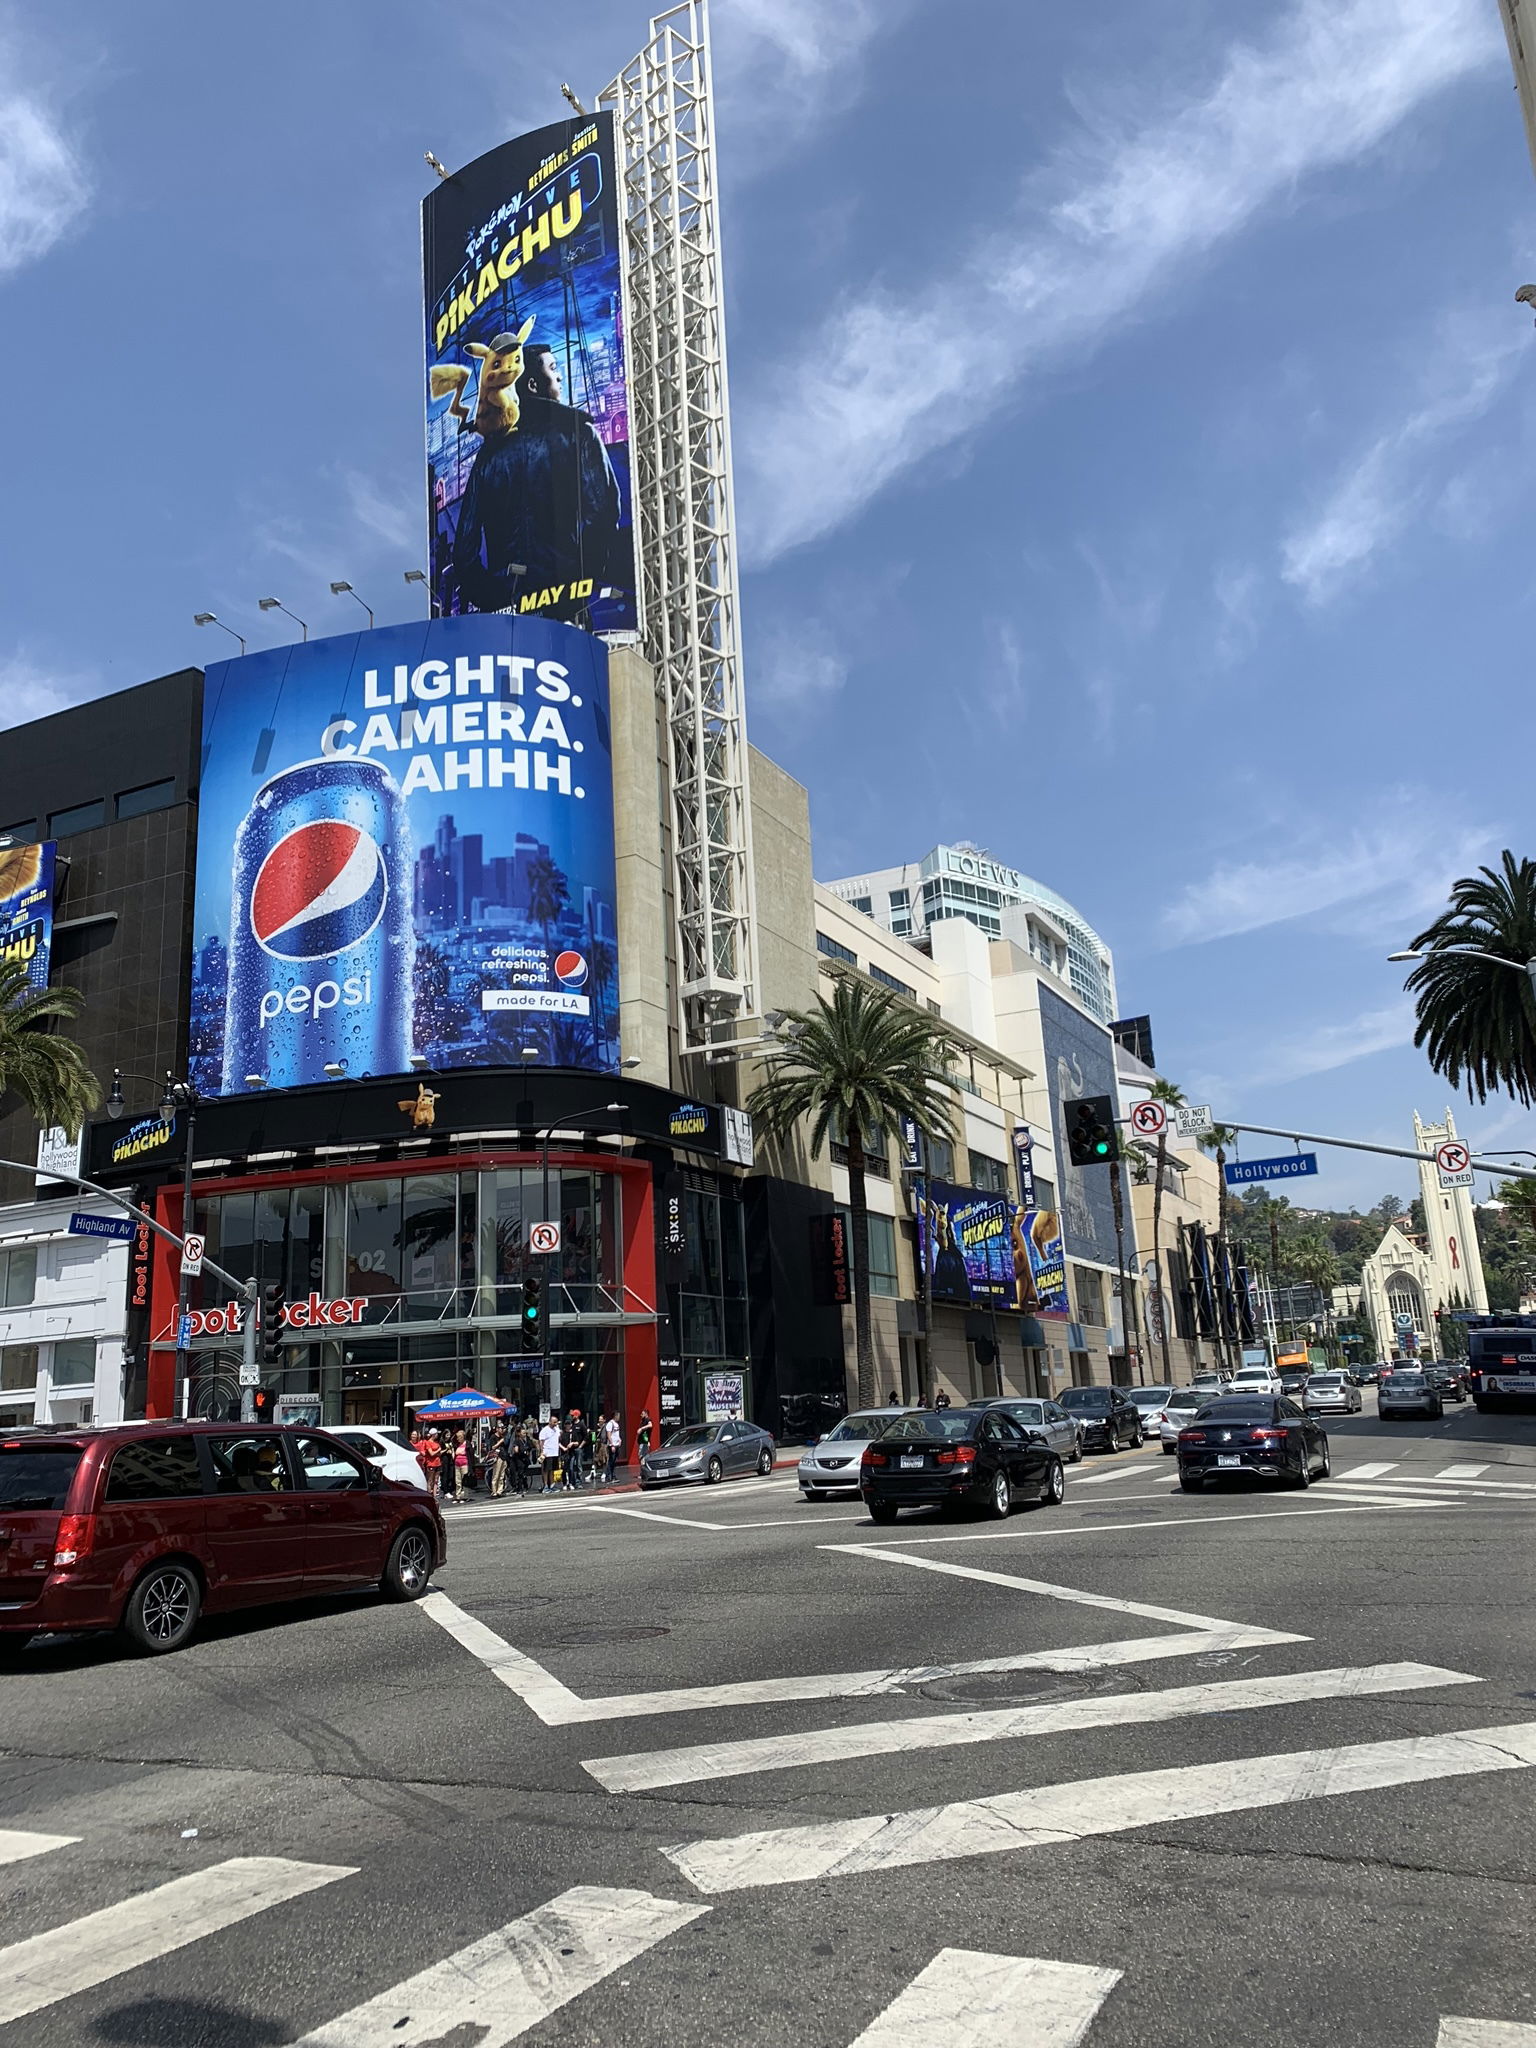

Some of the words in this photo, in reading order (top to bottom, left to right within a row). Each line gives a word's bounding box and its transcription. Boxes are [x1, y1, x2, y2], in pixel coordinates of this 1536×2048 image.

[572, 128, 598, 156] SMITH
[528, 149, 569, 191] REYNOLDS
[439, 169, 580, 316] DETECTIVE
[436, 189, 582, 351] PIKACHU
[520, 585, 565, 613] MAY
[569, 578, 593, 600] 10
[364, 655, 583, 708] LIGHTS.
[321, 702, 585, 757] CAMERA.
[401, 747, 586, 799] AHHH.
[947, 851, 1021, 889] LOEWS
[491, 946, 550, 958] delicious.
[481, 959, 550, 972] refreshing.
[512, 973, 550, 984] pepsi.
[259, 970, 372, 1028] pepsi
[497, 995, 536, 1006] made
[540, 996, 558, 1006] for
[1179, 1110, 1189, 1119] DO
[1192, 1108, 1206, 1117] NOT
[1182, 1118, 1206, 1128] BLOCK
[670, 1118, 705, 1134] PIKACHU
[906, 1123, 916, 1143] DRINK
[1179, 1126, 1212, 1135] INTERSECTION
[113, 1127, 169, 1162] PIKACHU
[1024, 1171, 1032, 1188] DRINK
[1234, 1160, 1307, 1179] Hollywood
[1443, 1176, 1454, 1184] ON
[1456, 1174, 1471, 1183] RED
[76, 1218, 116, 1233] Highland
[118, 1223, 131, 1235] Av
[669, 1198, 679, 1243] SIX:02
[183, 1263, 190, 1271] ON
[190, 1264, 199, 1272] RED
[133, 1266, 147, 1305] Foot
